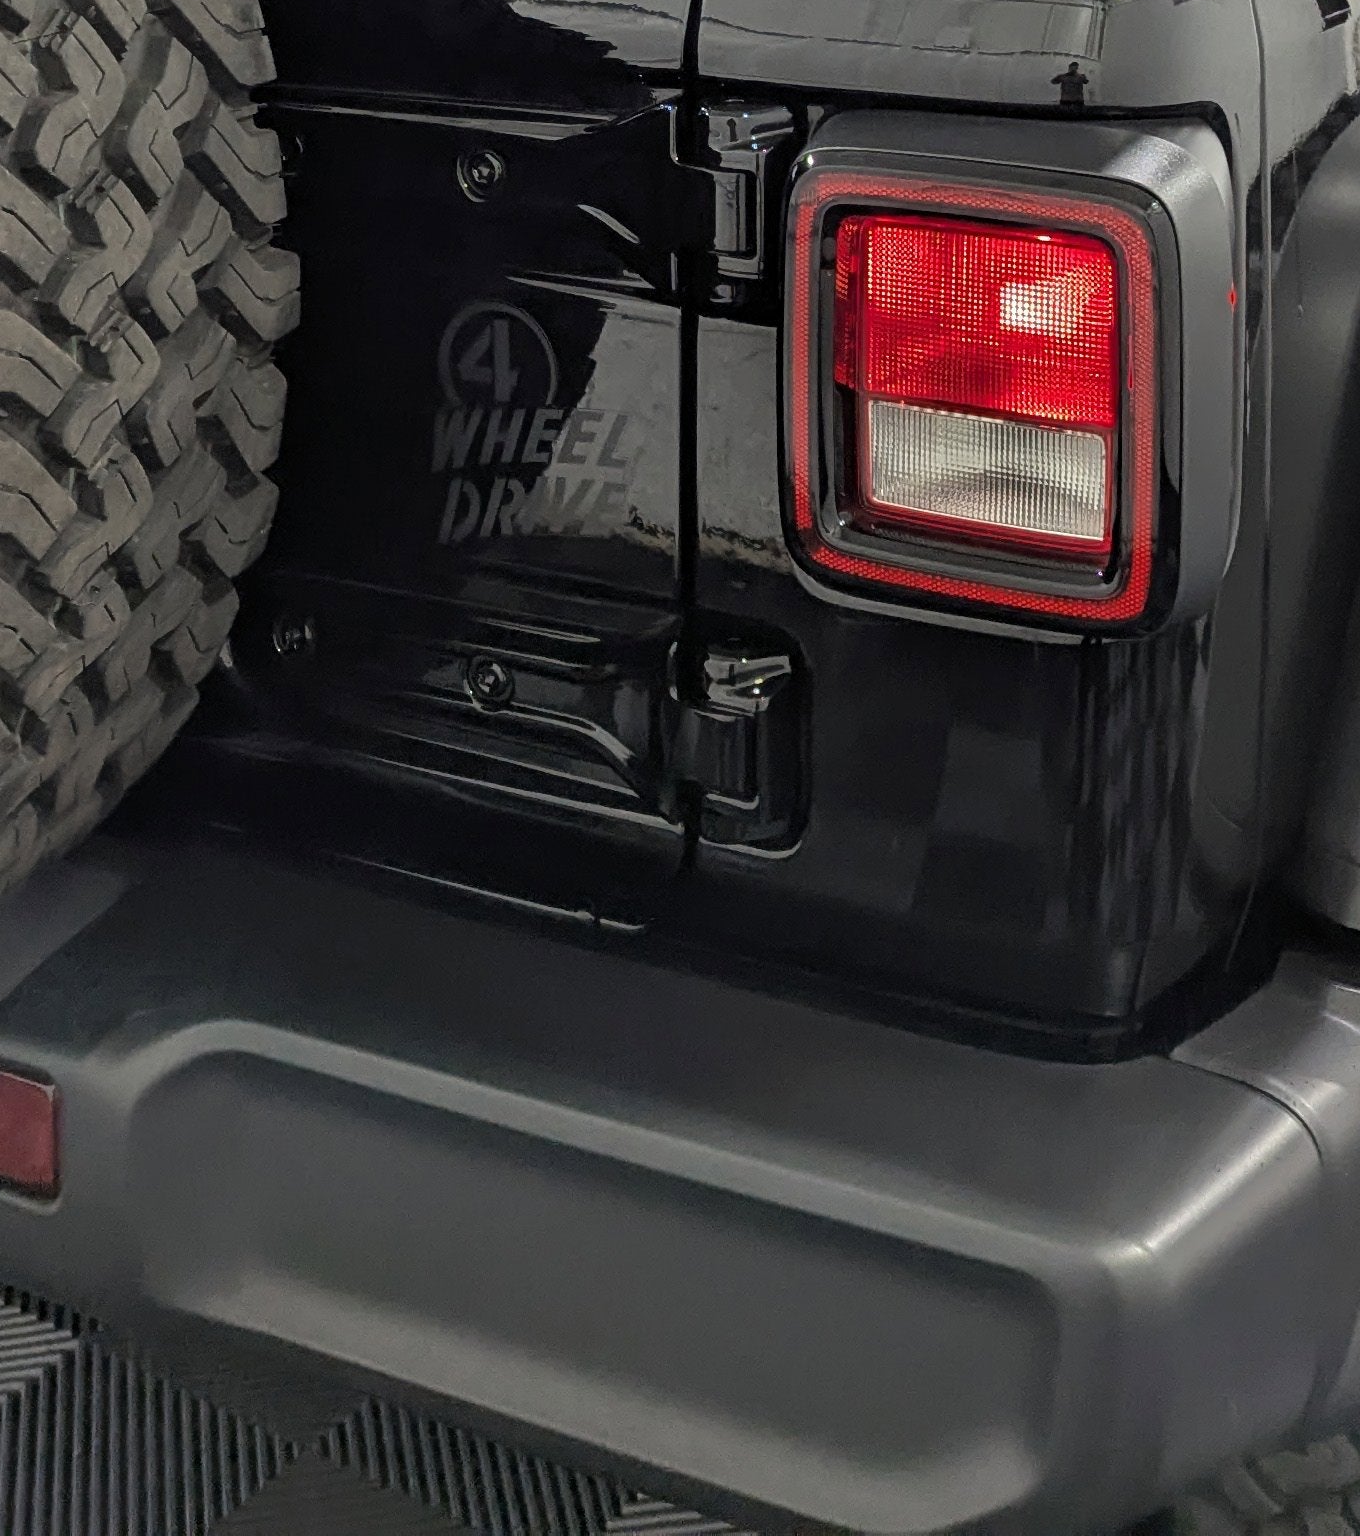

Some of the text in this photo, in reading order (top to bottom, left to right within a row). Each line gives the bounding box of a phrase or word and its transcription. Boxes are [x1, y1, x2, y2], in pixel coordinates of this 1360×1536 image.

[456, 318, 520, 403] 4
[431, 406, 632, 473] WHEEL
[438, 475, 631, 545] DRIVE
